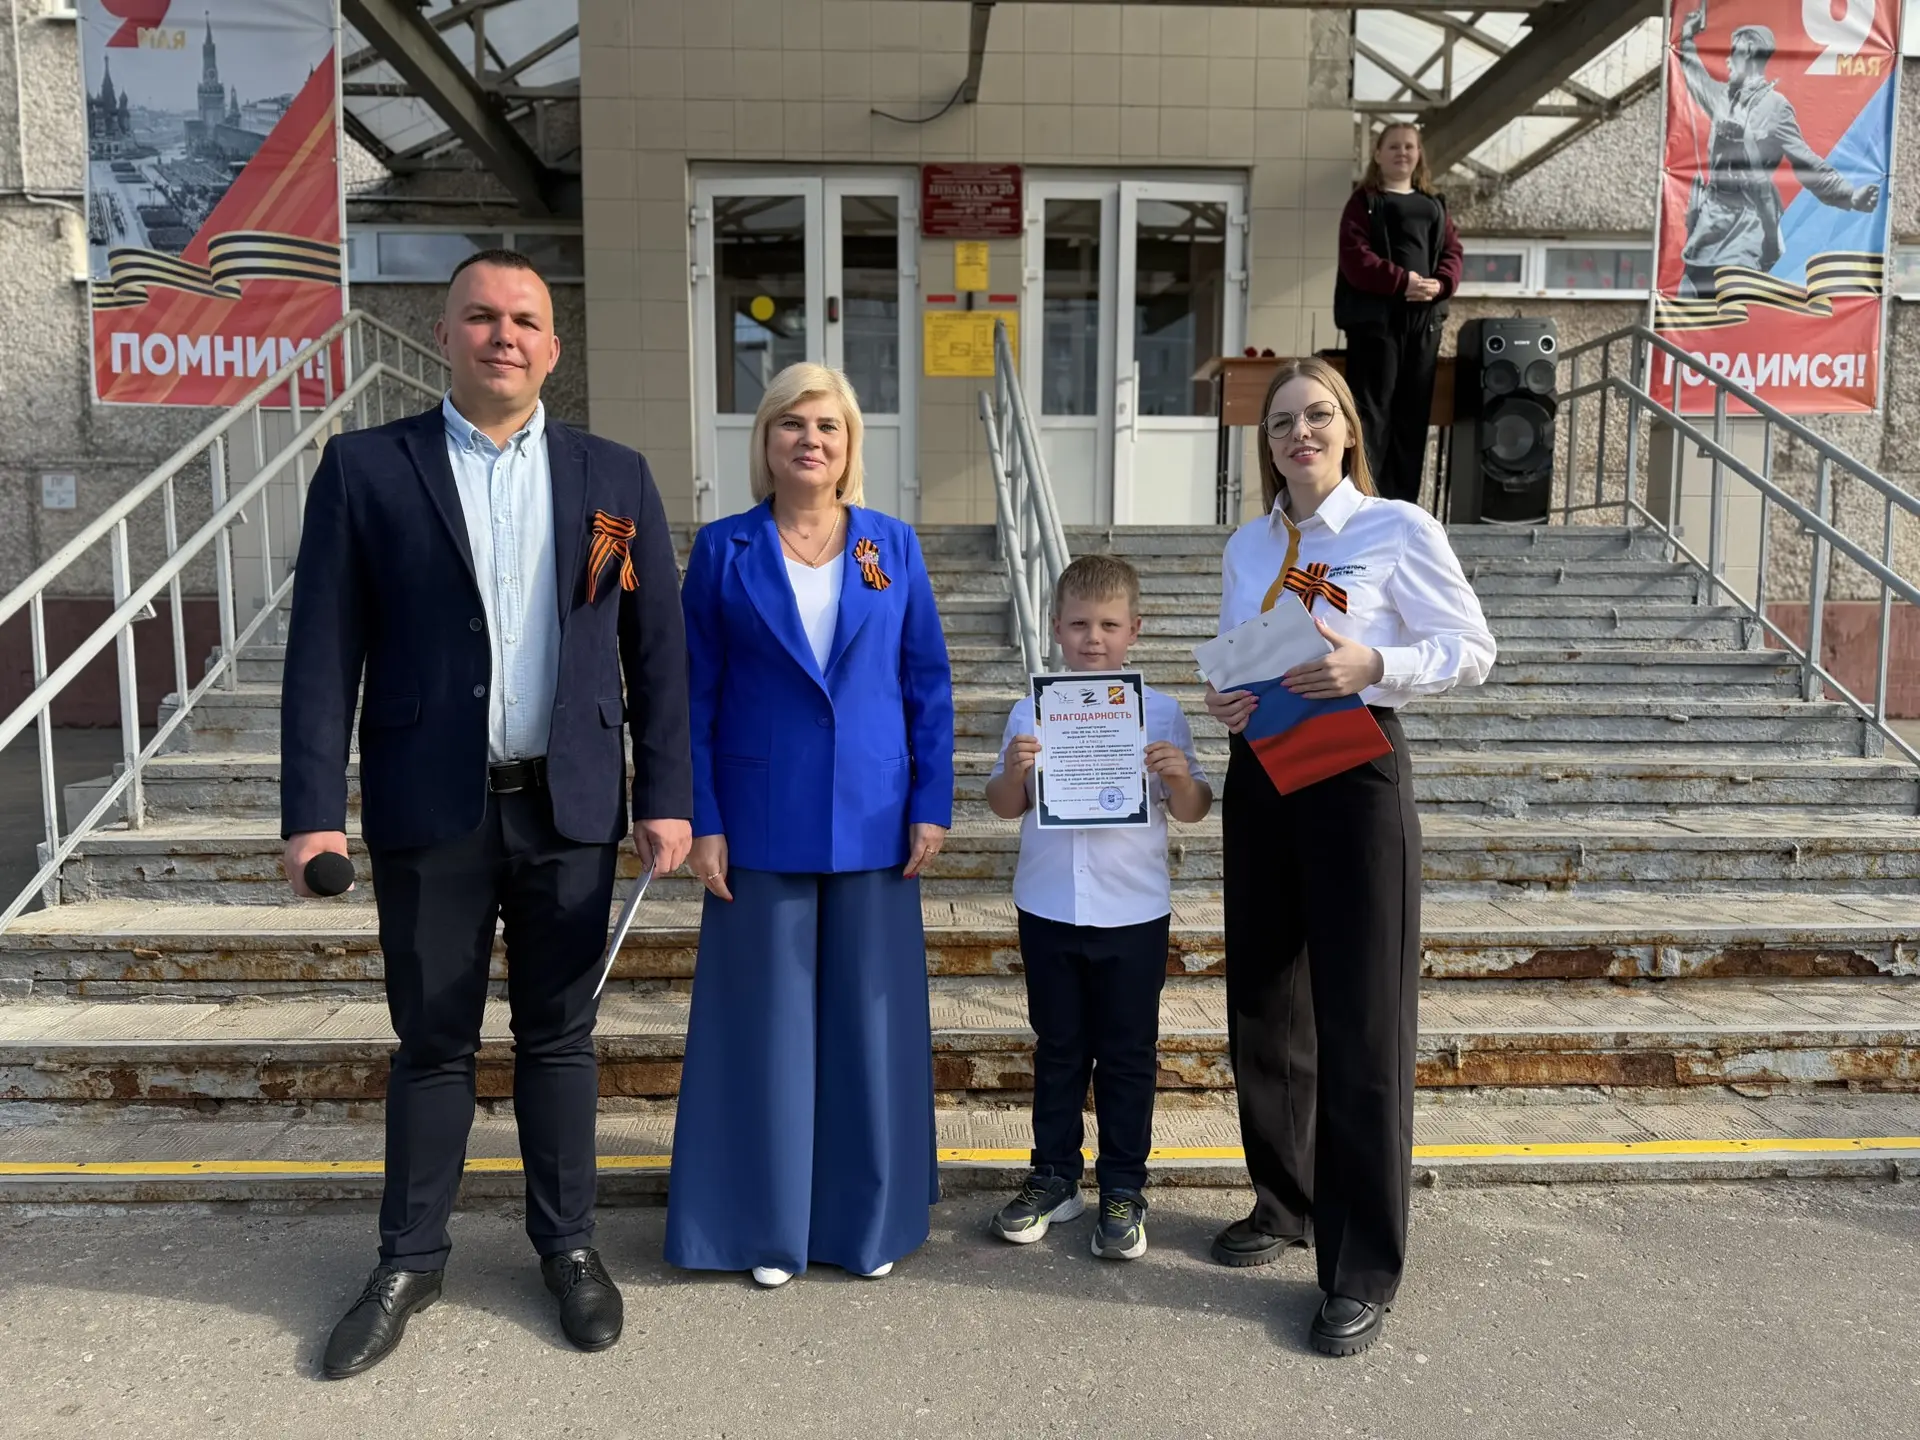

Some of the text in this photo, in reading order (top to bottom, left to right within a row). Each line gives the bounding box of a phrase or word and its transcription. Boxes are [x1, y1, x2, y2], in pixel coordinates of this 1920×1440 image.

[137, 27, 186, 50] МАЯ
[1837, 53, 1881, 76] МАЯ
[928, 184, 980, 195] ШКОЛА
[998, 184, 1016, 195] 20
[1049, 711, 1132, 722] БЛАГОДАРНОСТЬ
